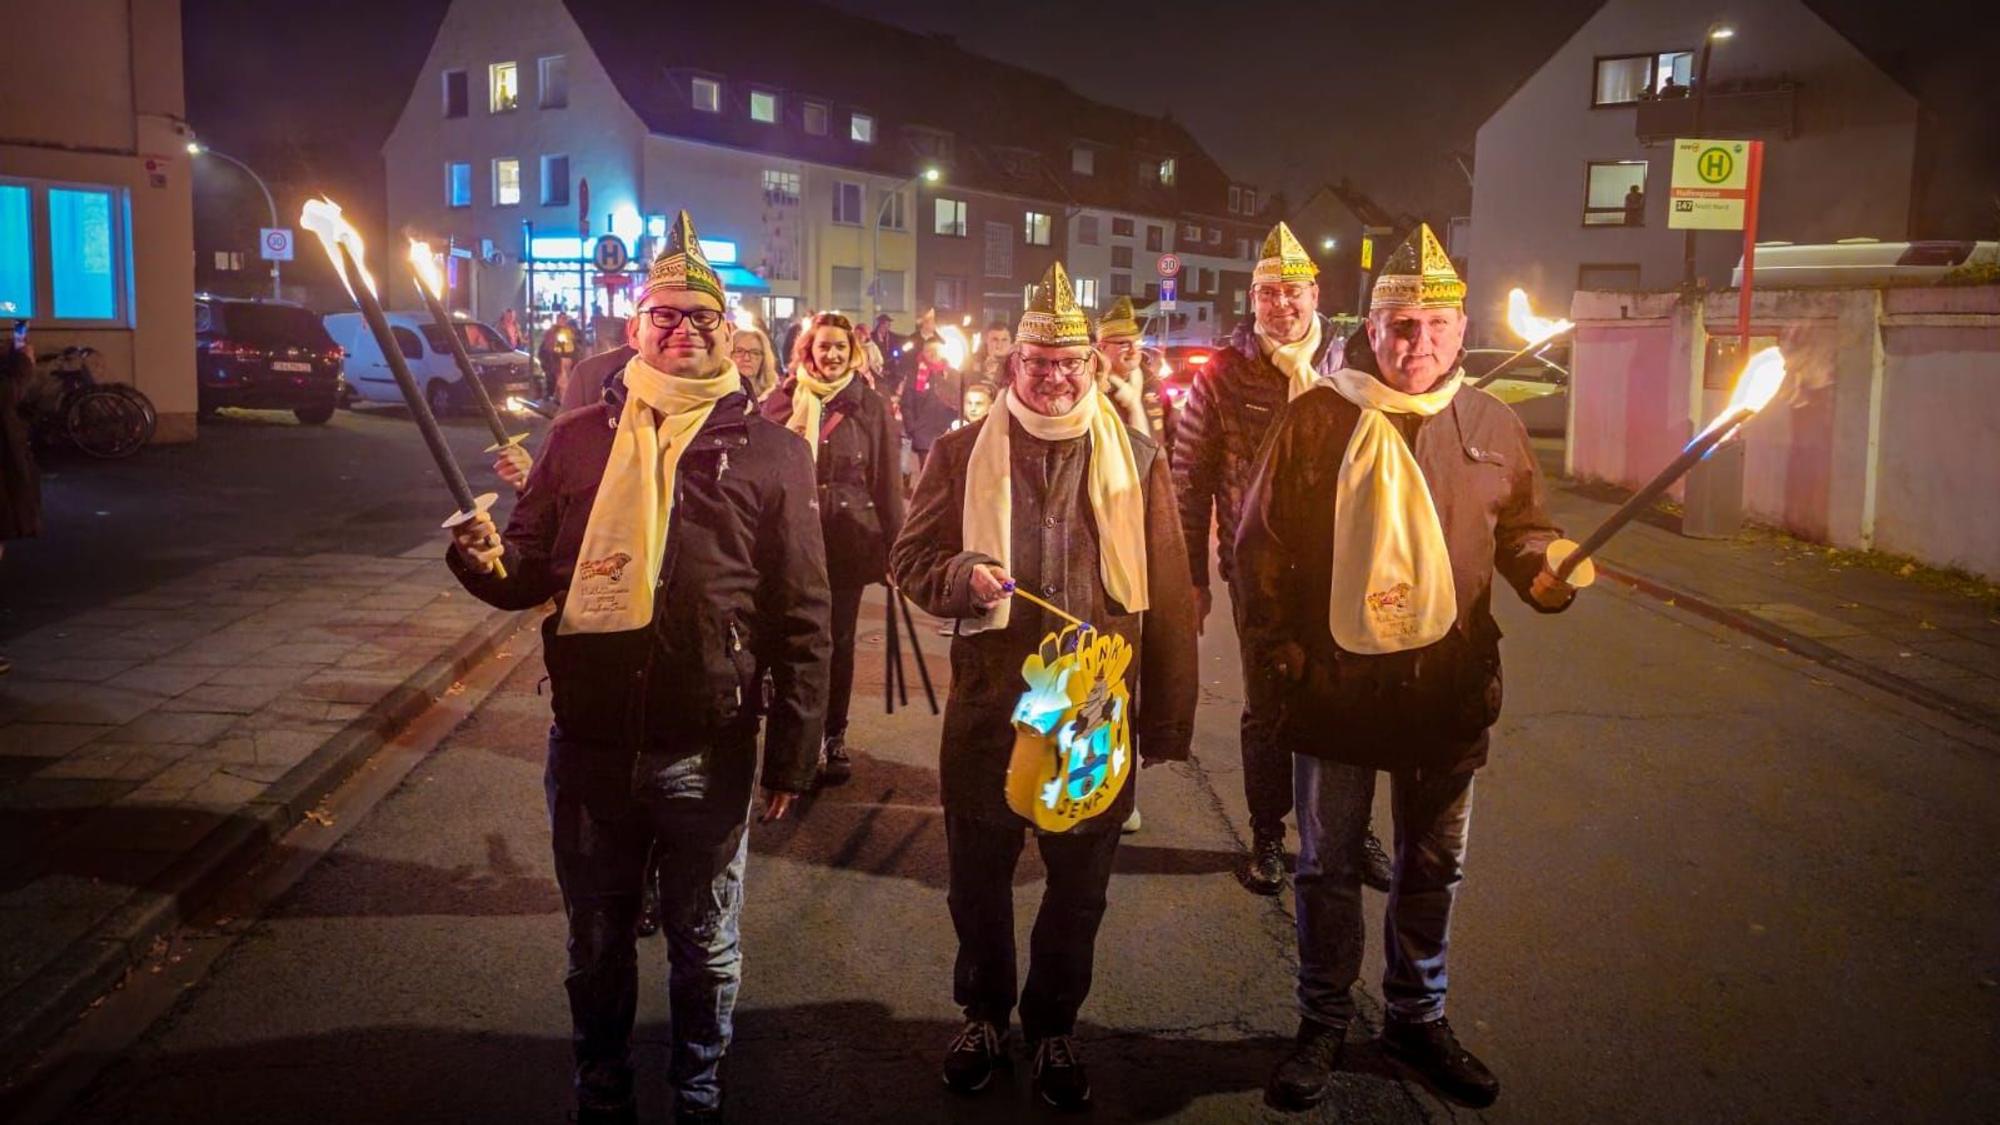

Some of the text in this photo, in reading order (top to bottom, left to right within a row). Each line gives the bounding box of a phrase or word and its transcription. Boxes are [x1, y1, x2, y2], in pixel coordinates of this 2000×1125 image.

[1706, 154, 1724, 177] H
[1677, 201, 1692, 210] 147
[602, 244, 620, 265] H
[1162, 260, 1175, 270] 30
[1056, 778, 1110, 818] SENAT
